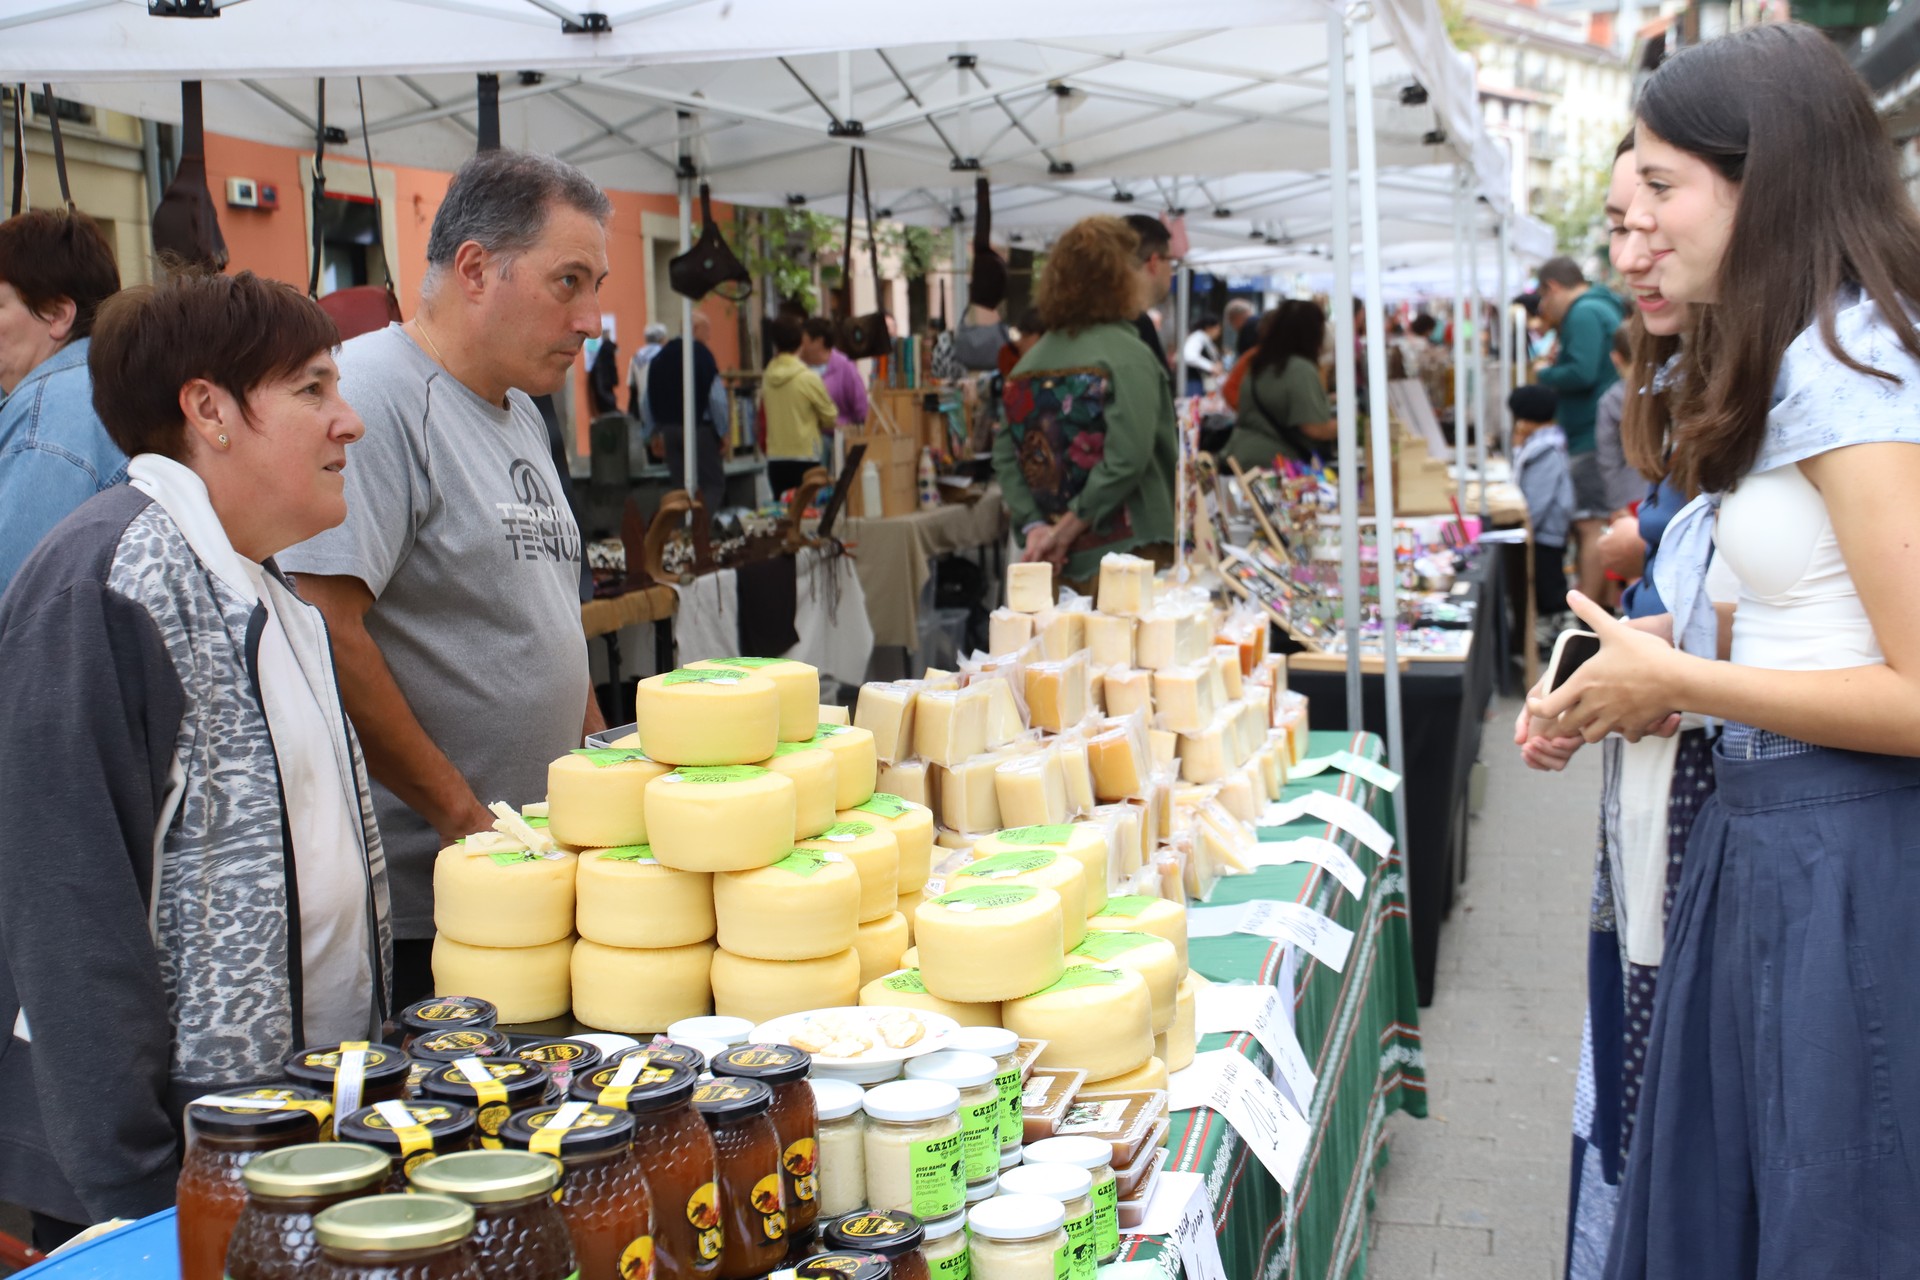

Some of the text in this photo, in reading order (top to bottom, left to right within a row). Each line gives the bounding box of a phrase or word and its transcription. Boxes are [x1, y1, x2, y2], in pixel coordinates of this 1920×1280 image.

[994, 1073, 1016, 1086] AZTA
[926, 1137, 958, 1153] GAZTA
[929, 1163, 947, 1171] RAMÓN
[1097, 1181, 1115, 1196] GAZT
[1062, 1220, 1082, 1233] ZTA
[940, 1252, 966, 1270] GAZTA
